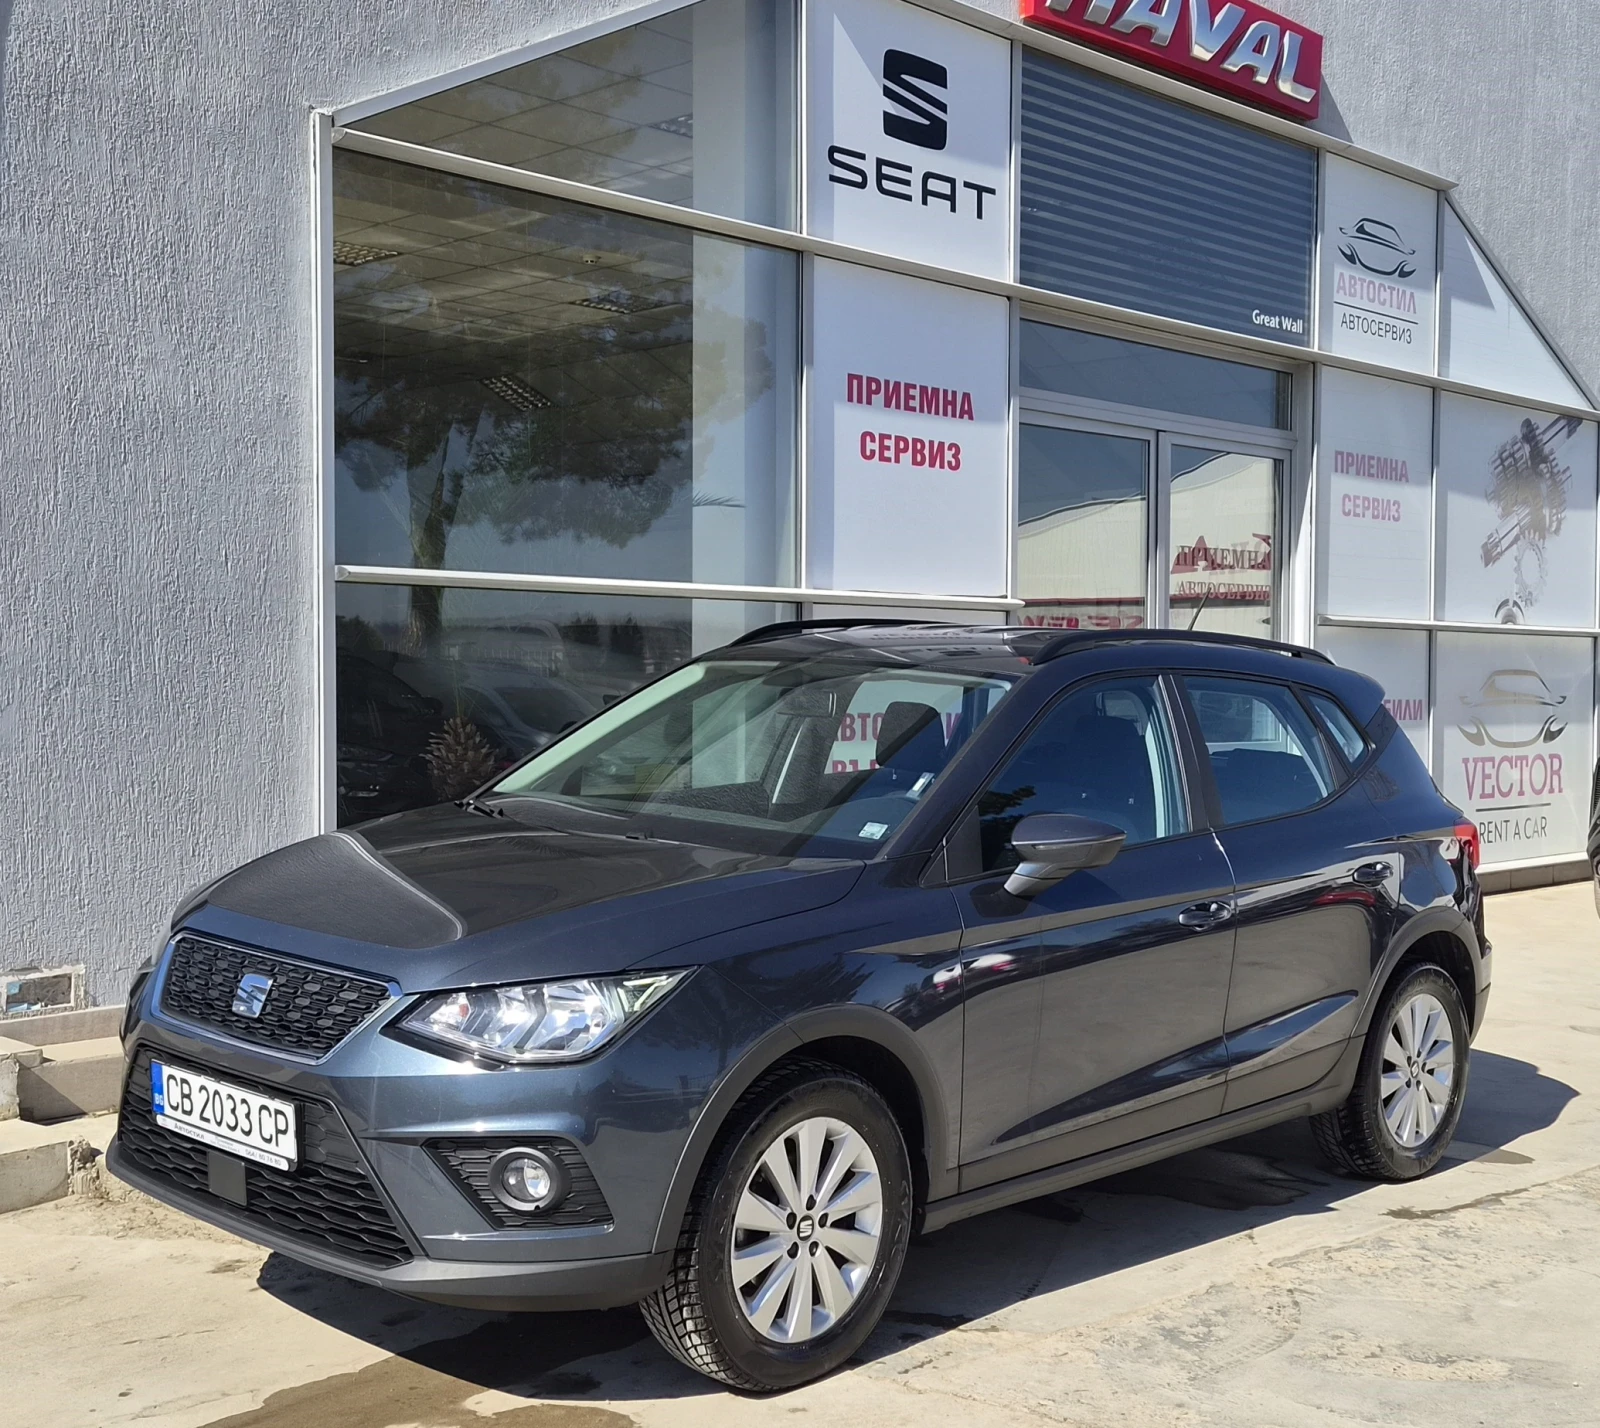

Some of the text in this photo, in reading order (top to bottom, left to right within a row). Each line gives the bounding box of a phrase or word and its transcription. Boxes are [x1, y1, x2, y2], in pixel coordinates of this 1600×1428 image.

[828, 145, 996, 220] SEAT
[1336, 272, 1417, 314] АВТОСТИЛ
[1252, 309, 1303, 334] Great Wall
[1340, 312, 1412, 344] АВТОСЕРВИЗ
[847, 372, 974, 421] ПРИЕМНА
[860, 430, 961, 471] СЕРВИЗ
[1334, 450, 1409, 483] ПРИЕМНА
[1341, 493, 1401, 522] СЕРВИЗ
[1462, 753, 1563, 801] VECTOR
[1479, 816, 1547, 844] RENT A CAR
[153, 1093, 164, 1106] BG
[166, 1074, 193, 1116] CB
[199, 1085, 253, 1136] 2033
[258, 1104, 289, 1147] CP
